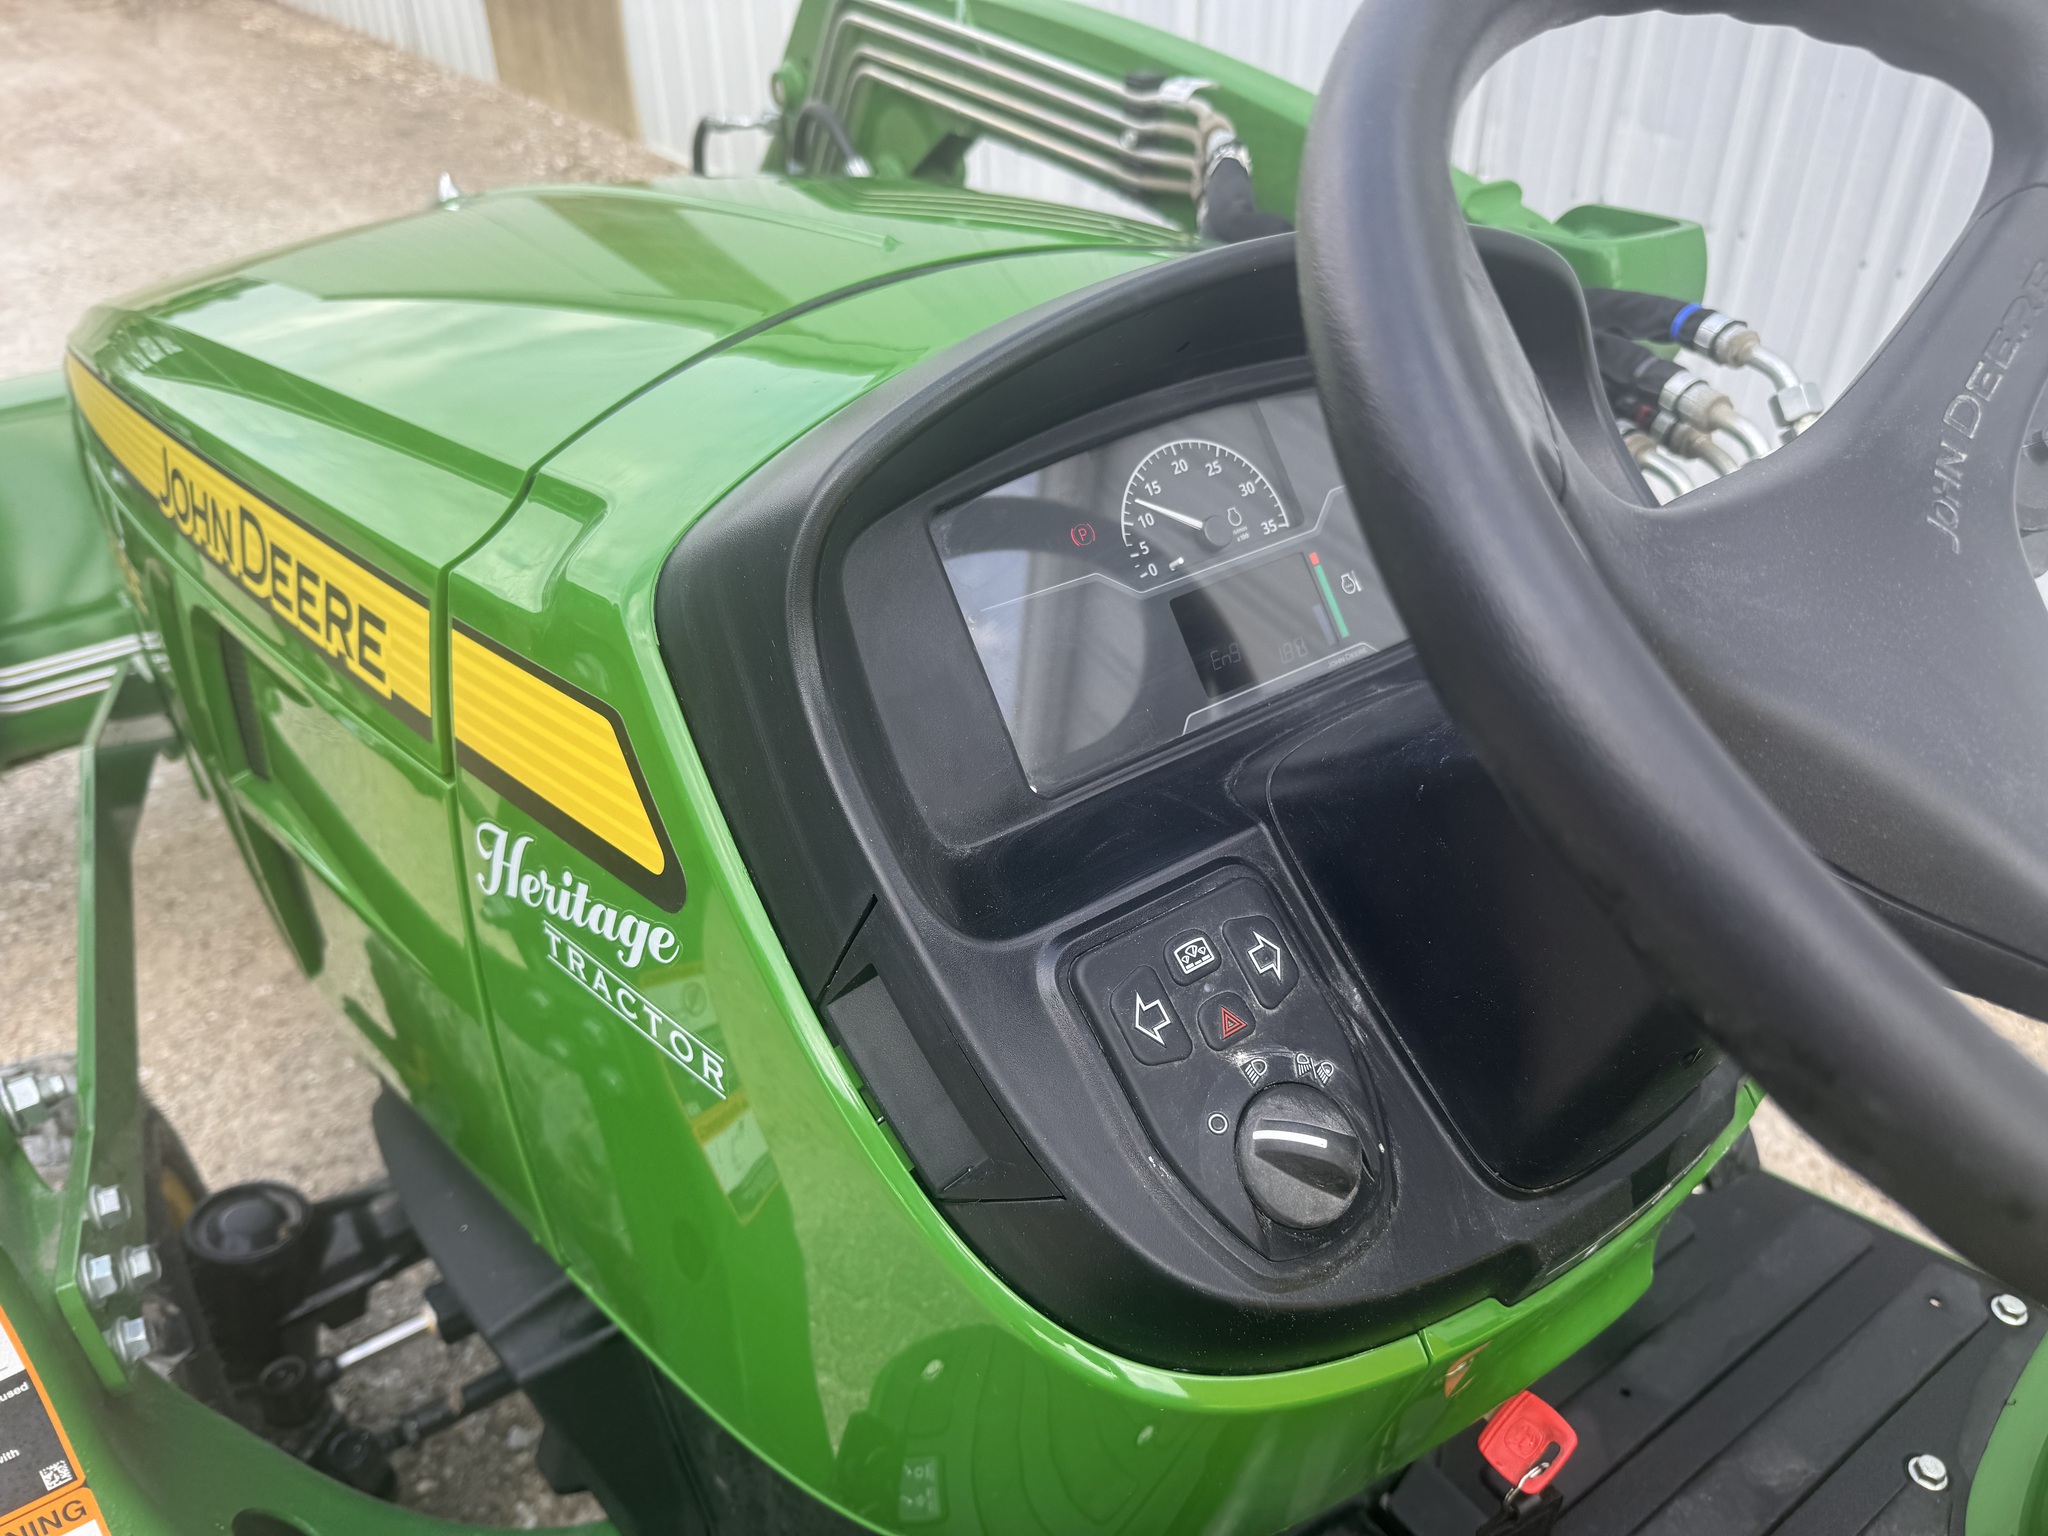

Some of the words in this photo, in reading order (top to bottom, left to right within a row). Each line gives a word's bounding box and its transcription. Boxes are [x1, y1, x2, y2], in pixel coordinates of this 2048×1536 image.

[1171, 459, 1189, 475] 20
[1205, 460, 1222, 477] 25
[1144, 480, 1162, 496] 15
[1238, 481, 1256, 497] 30
[1137, 513, 1155, 529] 10
[1260, 519, 1278, 536] 35
[1139, 541, 1150, 555] 5
[159, 445, 232, 567] JOHN
[239, 504, 387, 685] DEERE
[475, 821, 680, 968] Heritage
[545, 930, 725, 1092] TRACTOR
